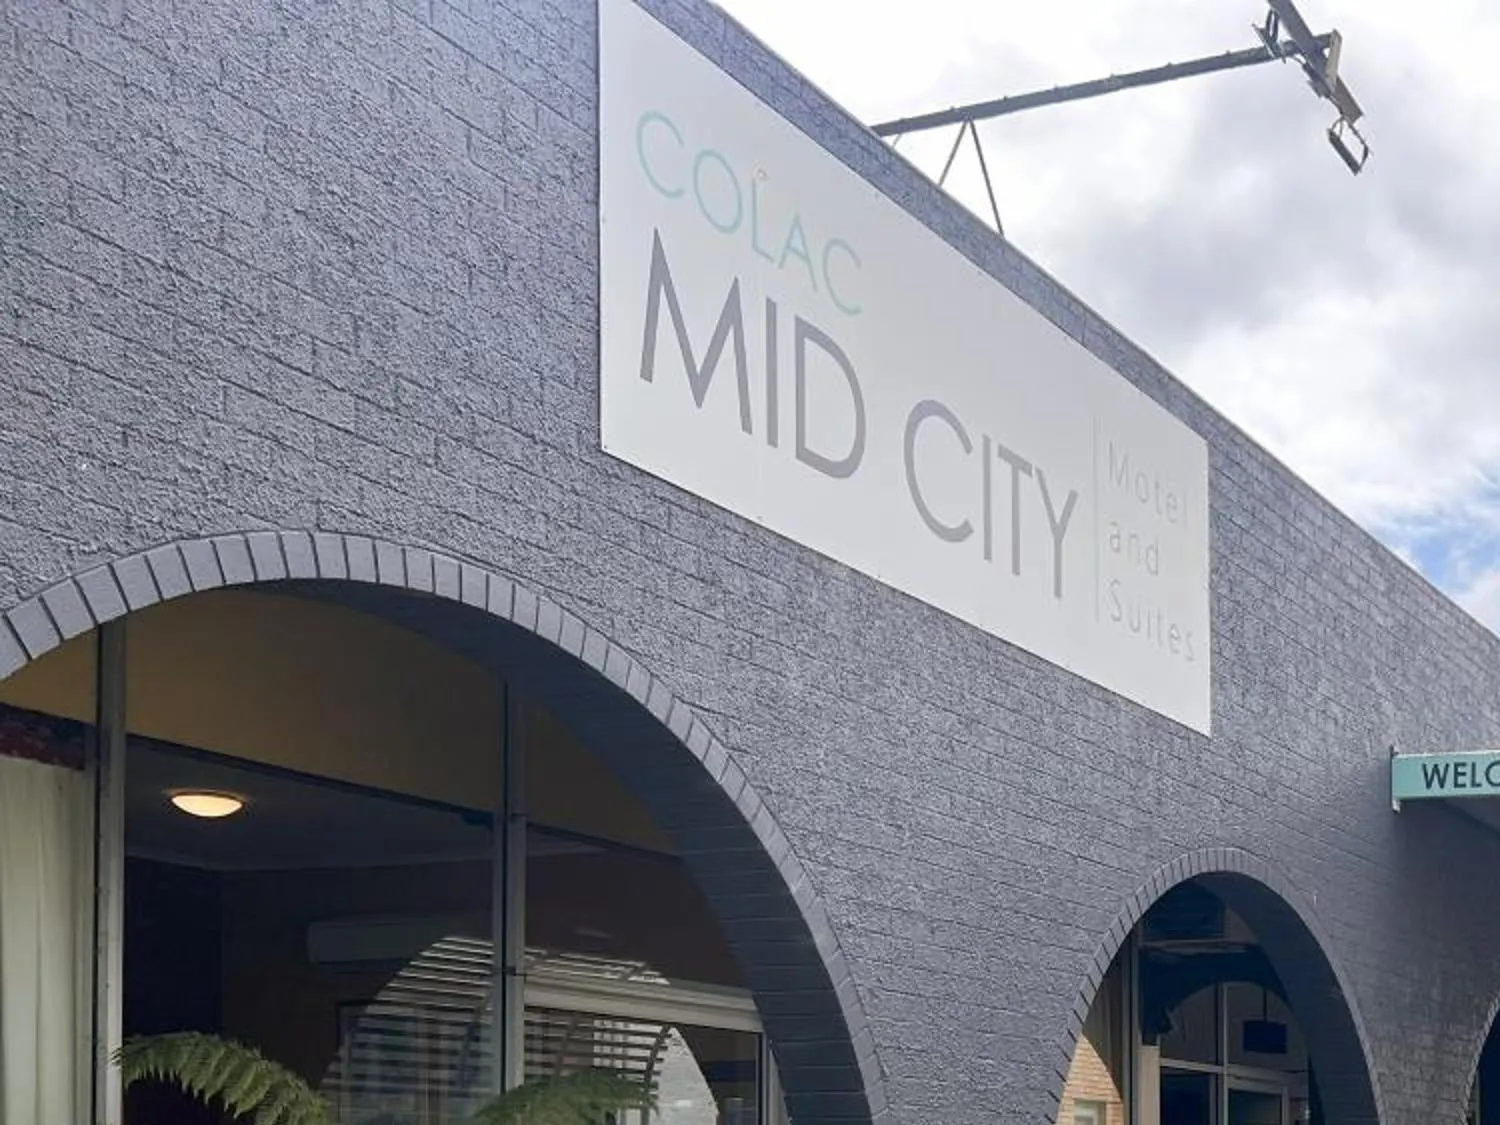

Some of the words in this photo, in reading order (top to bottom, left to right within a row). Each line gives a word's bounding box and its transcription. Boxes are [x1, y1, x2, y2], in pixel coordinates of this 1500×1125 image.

[635, 110, 862, 316] COLAC
[640, 226, 867, 480] MID
[904, 399, 1078, 600] CITY
[1109, 440, 1188, 531] Motel
[1109, 521, 1160, 577] and
[1109, 578, 1195, 663] Suites
